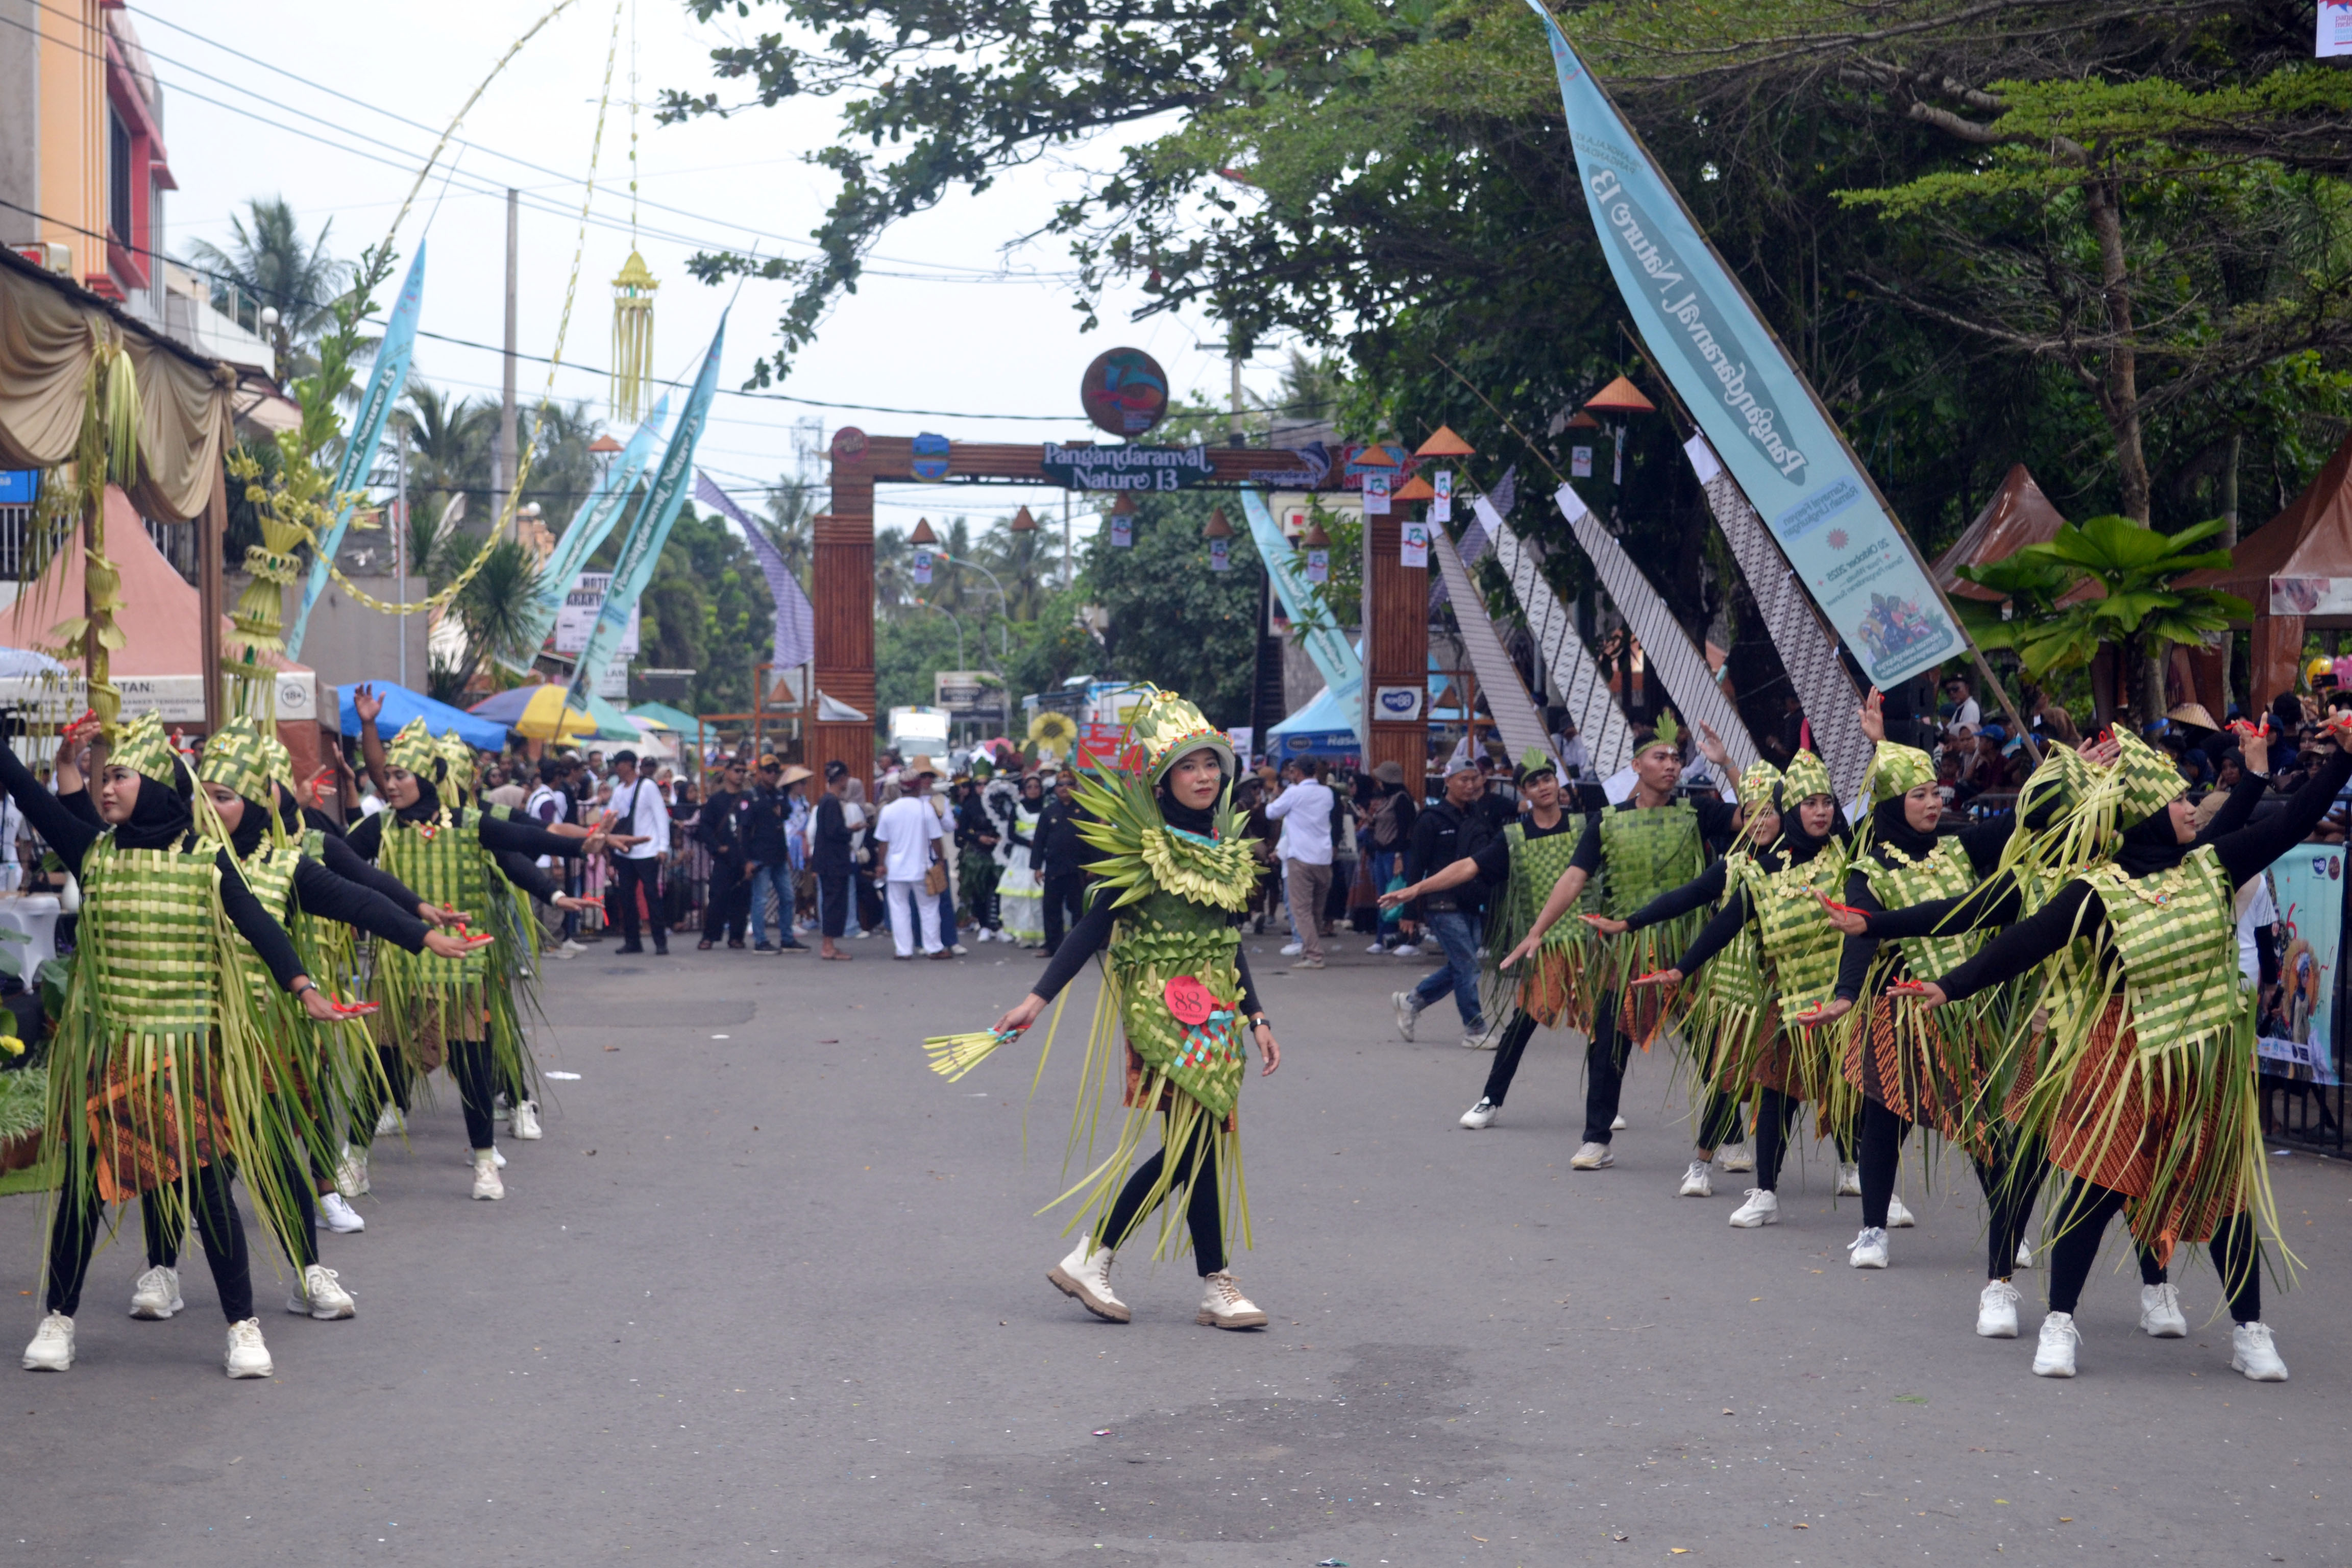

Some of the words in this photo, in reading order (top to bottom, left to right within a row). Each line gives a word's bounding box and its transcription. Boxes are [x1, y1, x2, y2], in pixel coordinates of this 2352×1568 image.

[380, 366, 397, 389] 13
[1044, 443, 1213, 473] Pangandaranval
[1073, 467, 1150, 490] Nature
[1156, 469, 1179, 492] 13
[284, 691, 302, 700] 18+
[1173, 990, 1202, 1012] 88
